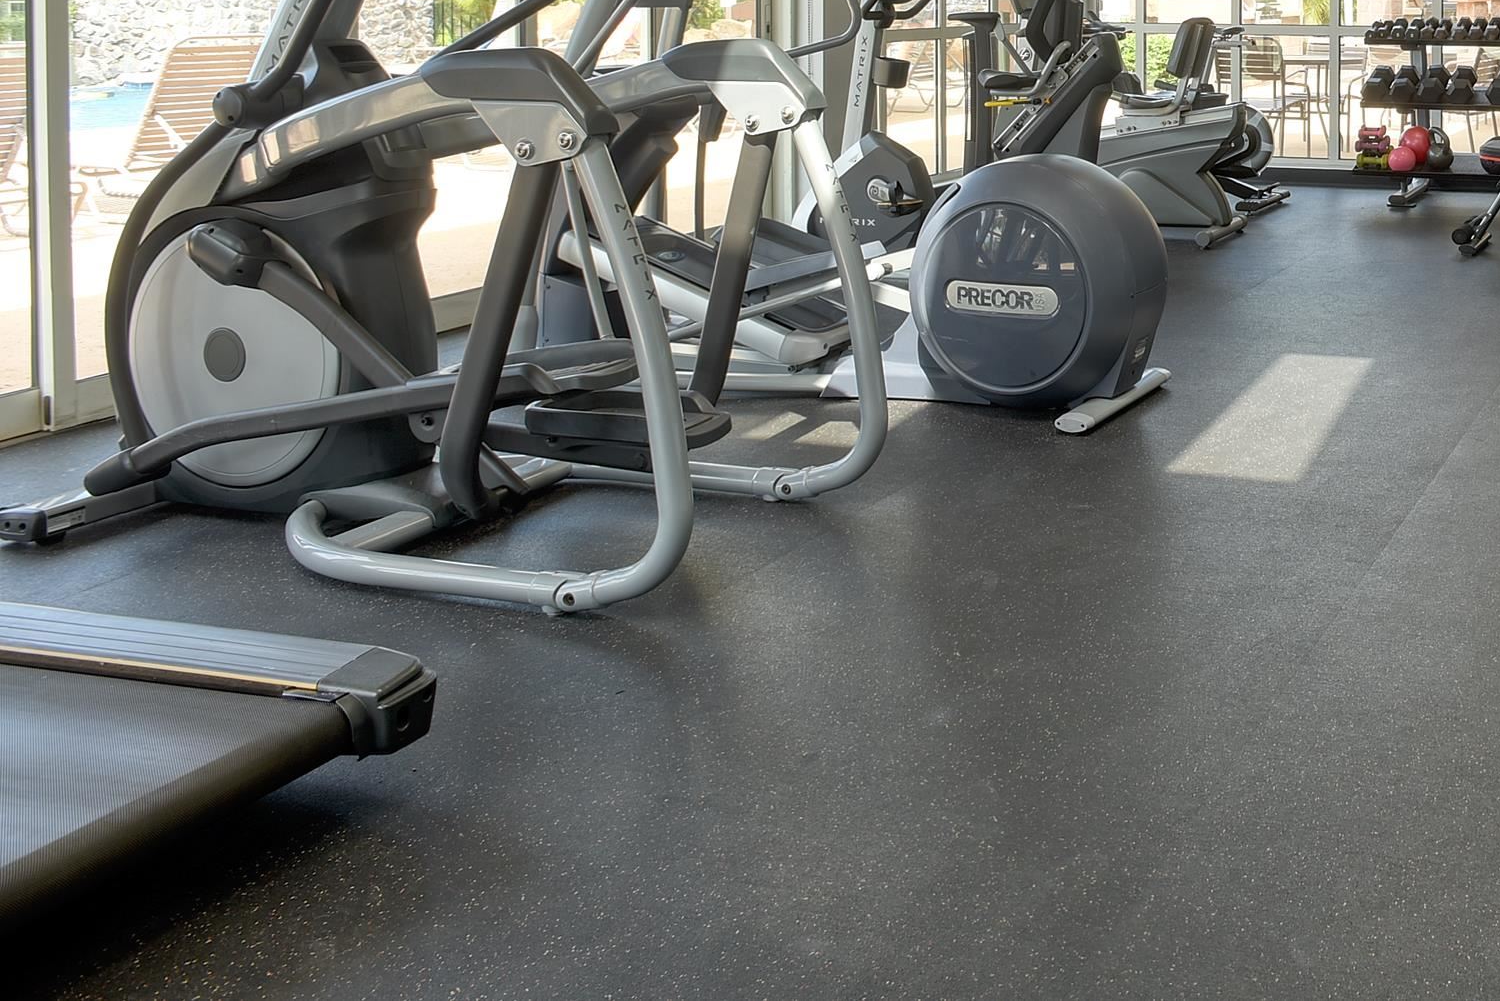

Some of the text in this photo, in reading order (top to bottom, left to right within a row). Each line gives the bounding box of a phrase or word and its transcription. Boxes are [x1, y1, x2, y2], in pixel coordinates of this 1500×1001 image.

[854, 35, 868, 107] MATRIX
[820, 218, 876, 227] MRIX
[614, 203, 657, 300] MATRIX
[957, 285, 1033, 310] PRECOR
